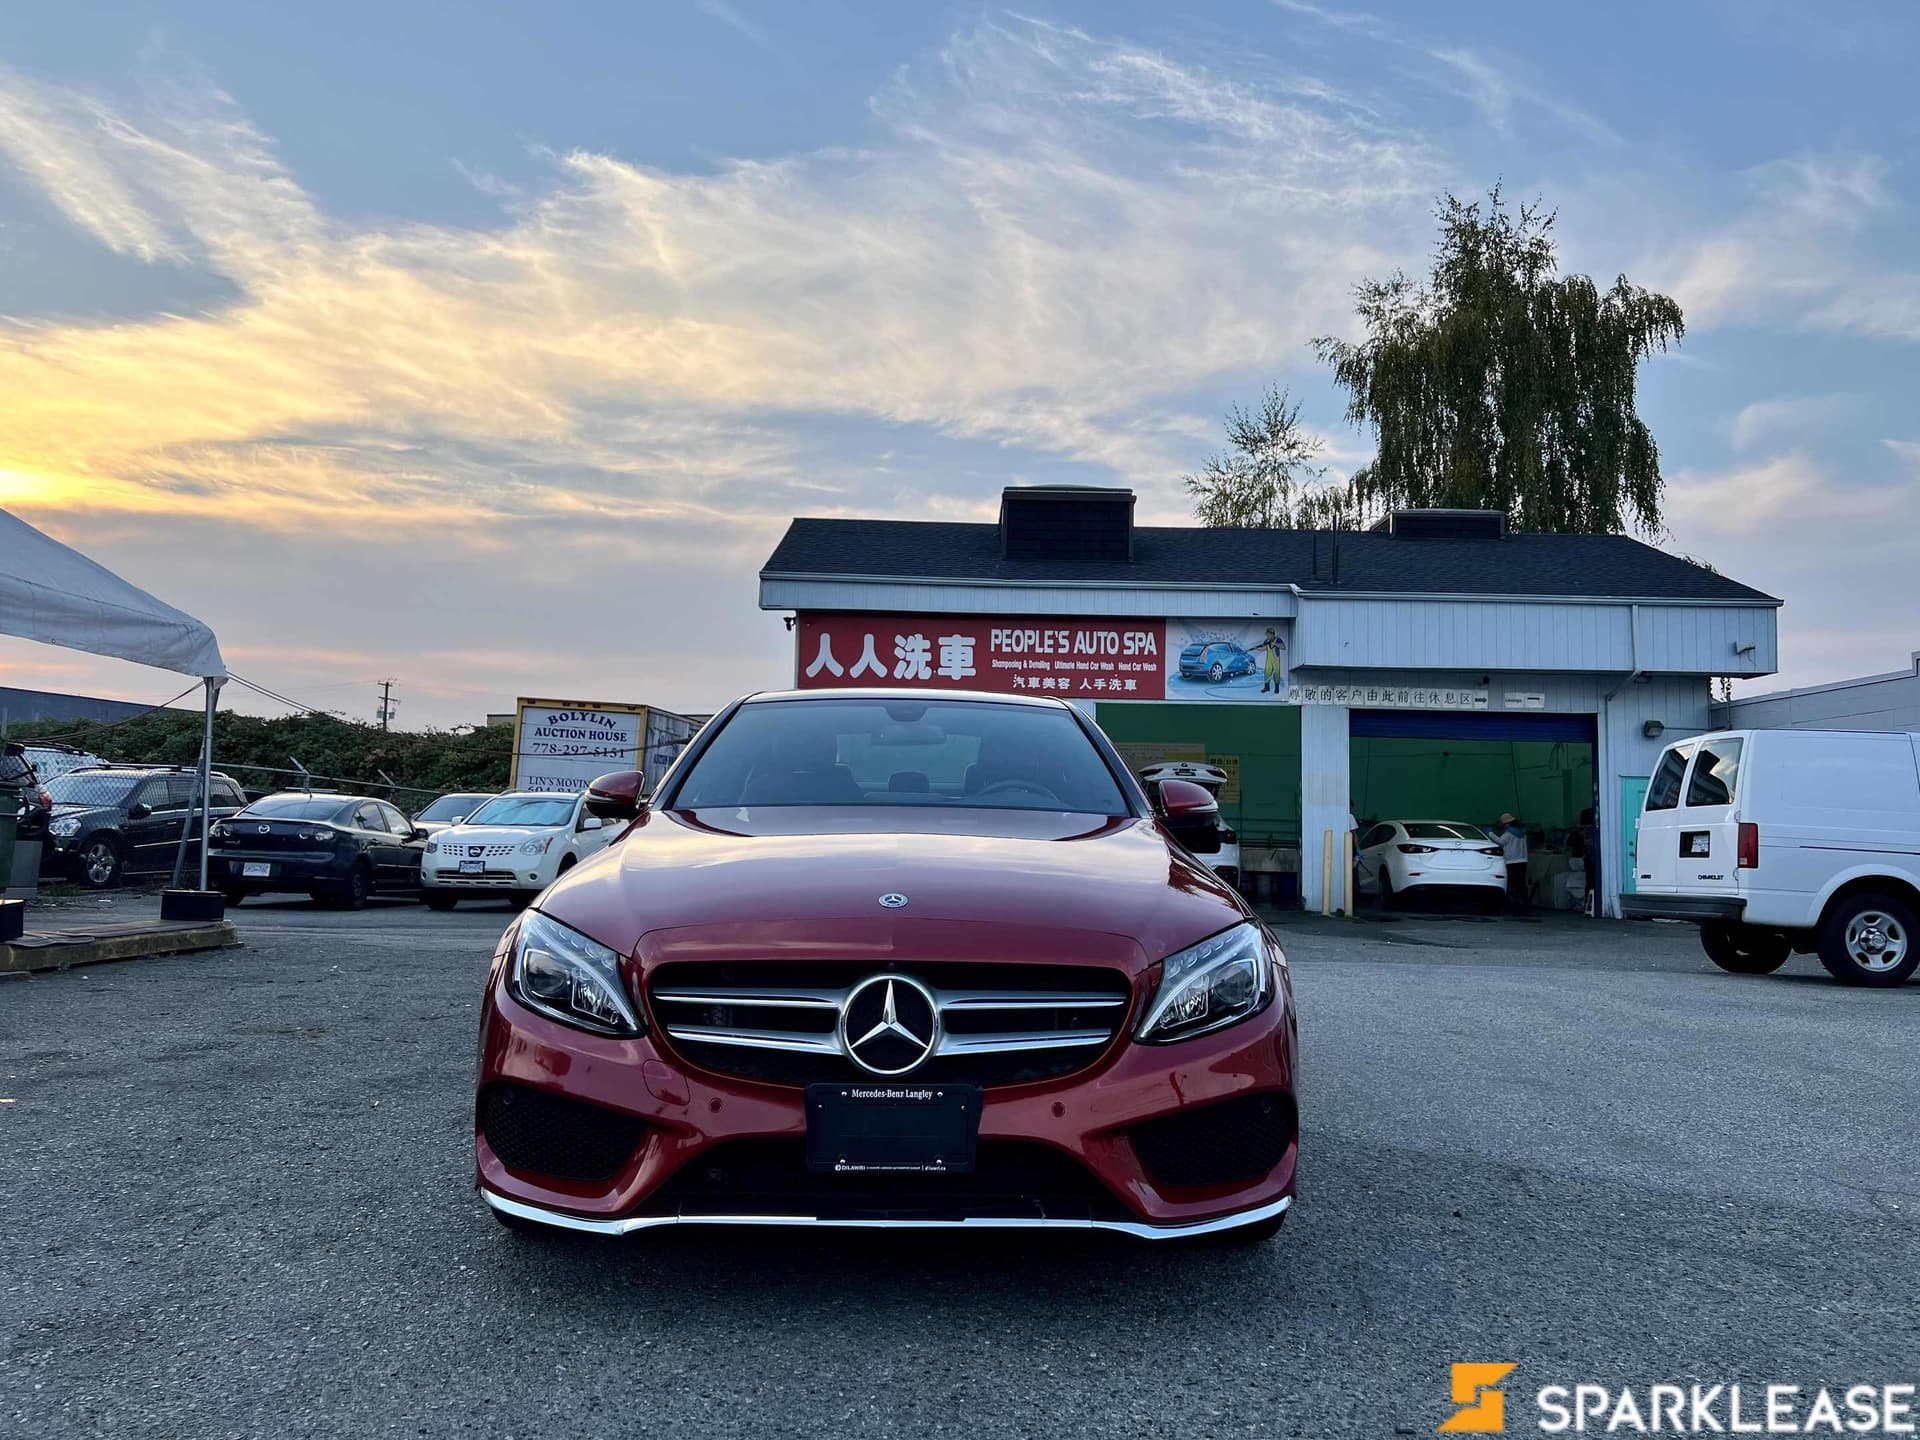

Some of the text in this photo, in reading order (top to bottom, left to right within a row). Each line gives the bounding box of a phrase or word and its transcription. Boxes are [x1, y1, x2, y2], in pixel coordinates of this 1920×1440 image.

[990, 629, 1158, 656] PEOPLE'S AUTO SPA
[805, 632, 977, 681] 人人洗車
[1023, 660, 1028, 669] &
[1076, 661, 1089, 670] Hand
[1090, 661, 1100, 670] Car
[1100, 661, 1115, 670] Wash
[1118, 662, 1132, 671] Hand
[1132, 662, 1142, 671] Car
[1142, 662, 1157, 672] Wash
[1012, 674, 1137, 691] 汽車美容 人手洗車
[547, 711, 617, 730] BOLYLIN
[534, 727, 628, 742] AUCTION HOUSE
[528, 776, 590, 789] LIN'S MOVIN
[851, 1088, 933, 1100] Mercedes-Benz Langley
